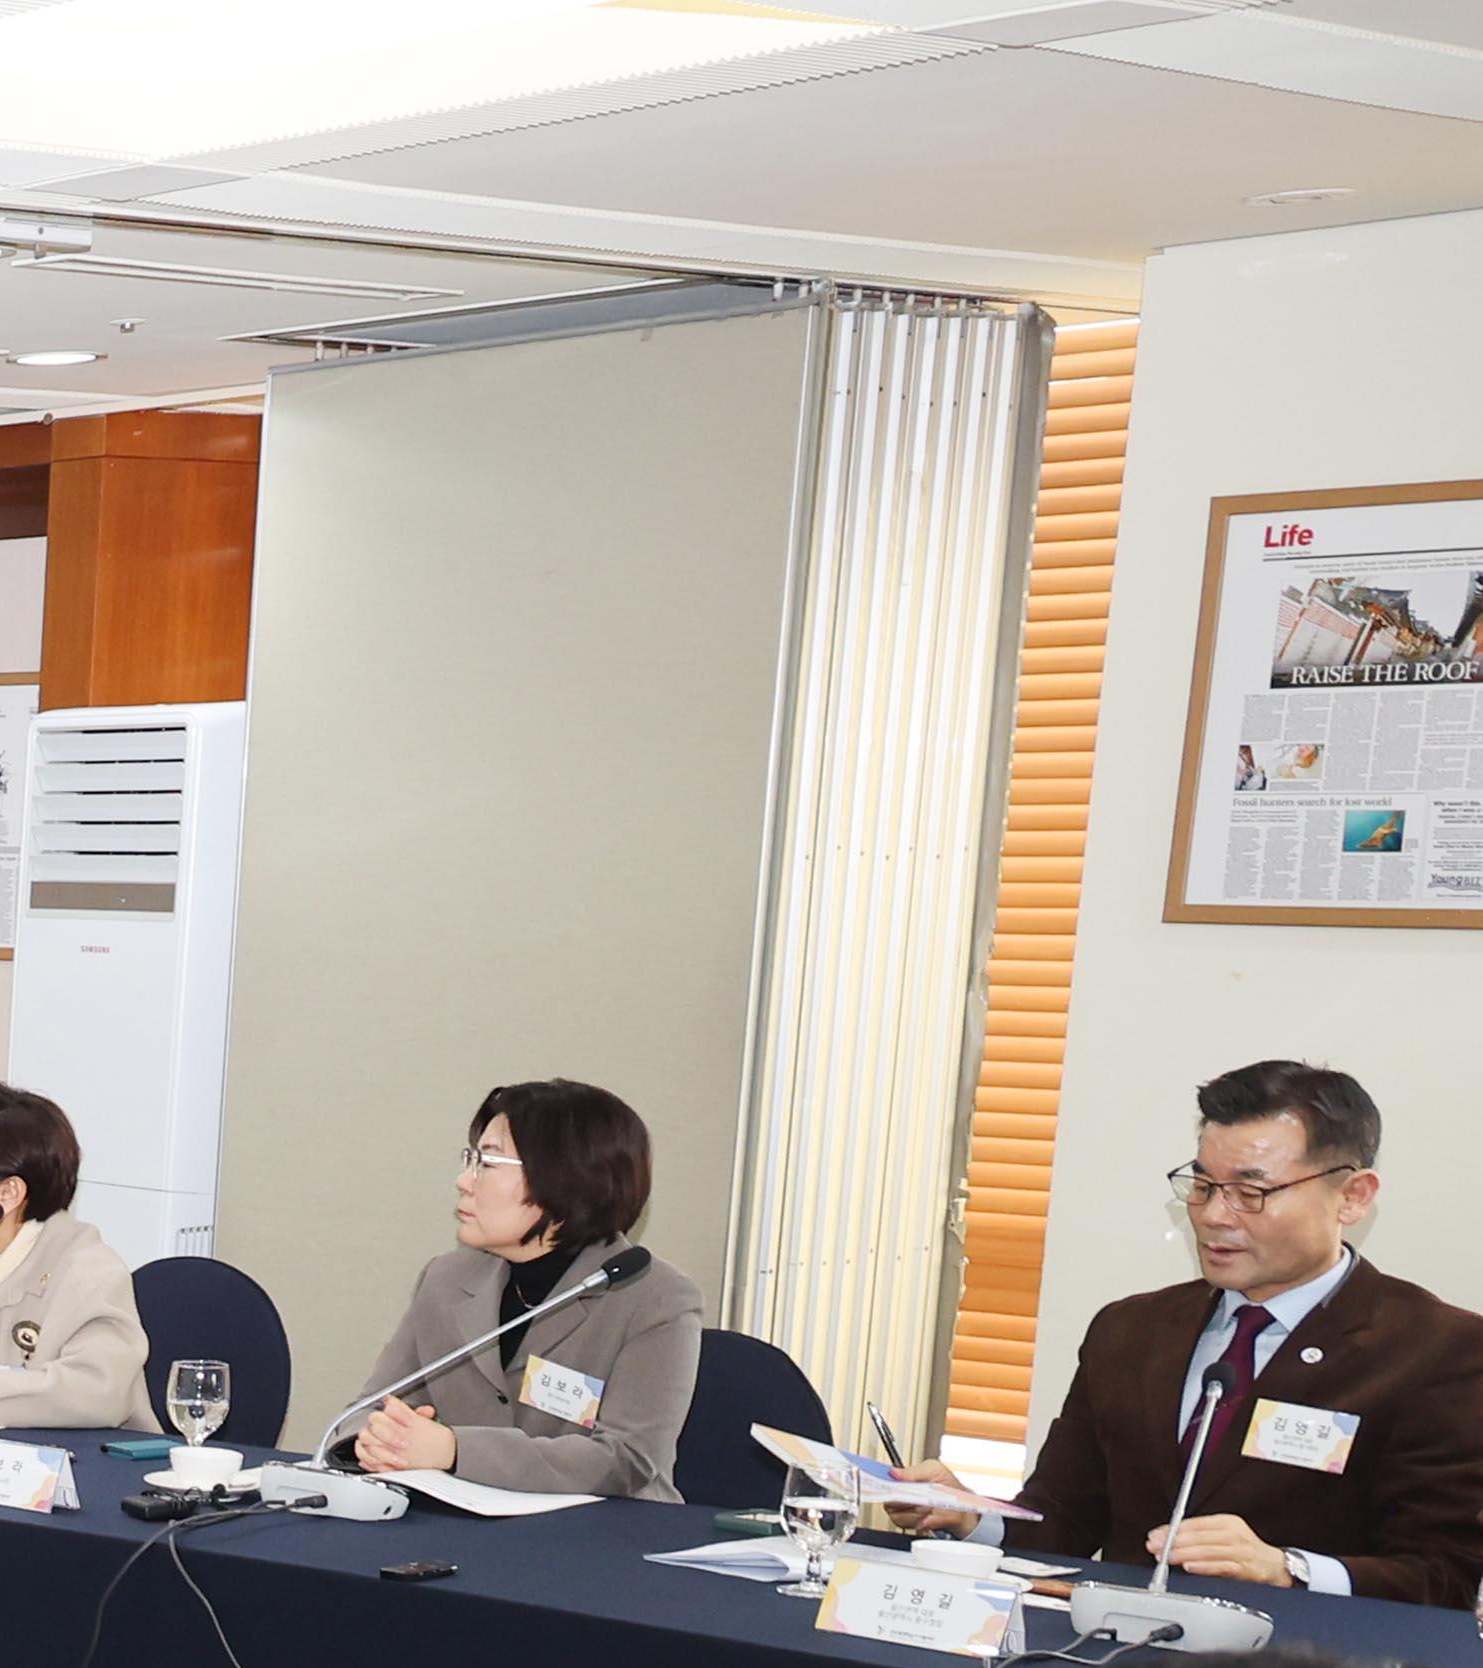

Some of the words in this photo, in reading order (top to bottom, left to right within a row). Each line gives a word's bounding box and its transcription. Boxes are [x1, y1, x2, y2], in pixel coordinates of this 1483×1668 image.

[1263, 524, 1314, 548] Life
[1291, 664, 1353, 685] RAISE
[1360, 663, 1409, 684] THE
[1413, 660, 1480, 681] ROOF
[1233, 797, 1257, 807] Fossil
[1260, 797, 1294, 807] hunters
[1297, 797, 1326, 807] search
[1330, 797, 1342, 806] for
[1345, 797, 1362, 806] lost
[1364, 797, 1393, 806] world
